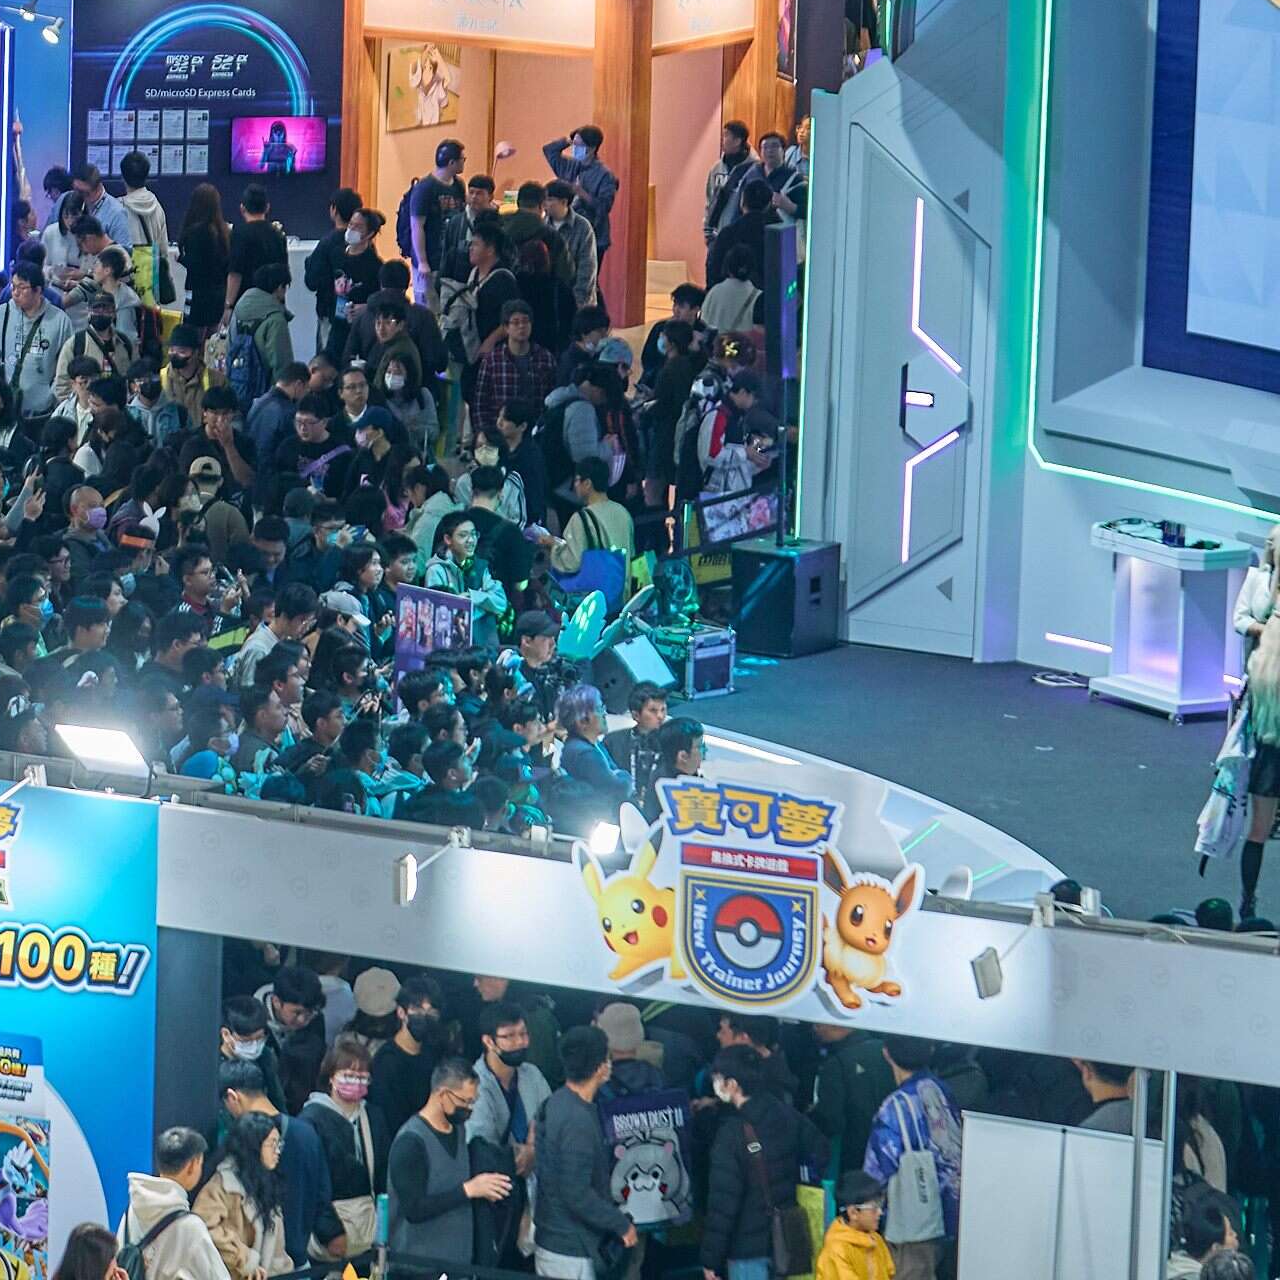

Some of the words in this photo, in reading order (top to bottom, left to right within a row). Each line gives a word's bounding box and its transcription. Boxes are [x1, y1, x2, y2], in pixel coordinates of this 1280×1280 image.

[145, 87, 197, 98] SD/microSD
[198, 88, 230, 99] Express
[231, 87, 257, 98] Cards
[666, 784, 835, 845] 寶可夢
[692, 903, 708, 950] New
[700, 950, 763, 991] Trainer
[765, 916, 806, 990] Journey
[612, 1112, 648, 1138] BROWN
[649, 1105, 674, 1129] DUST
